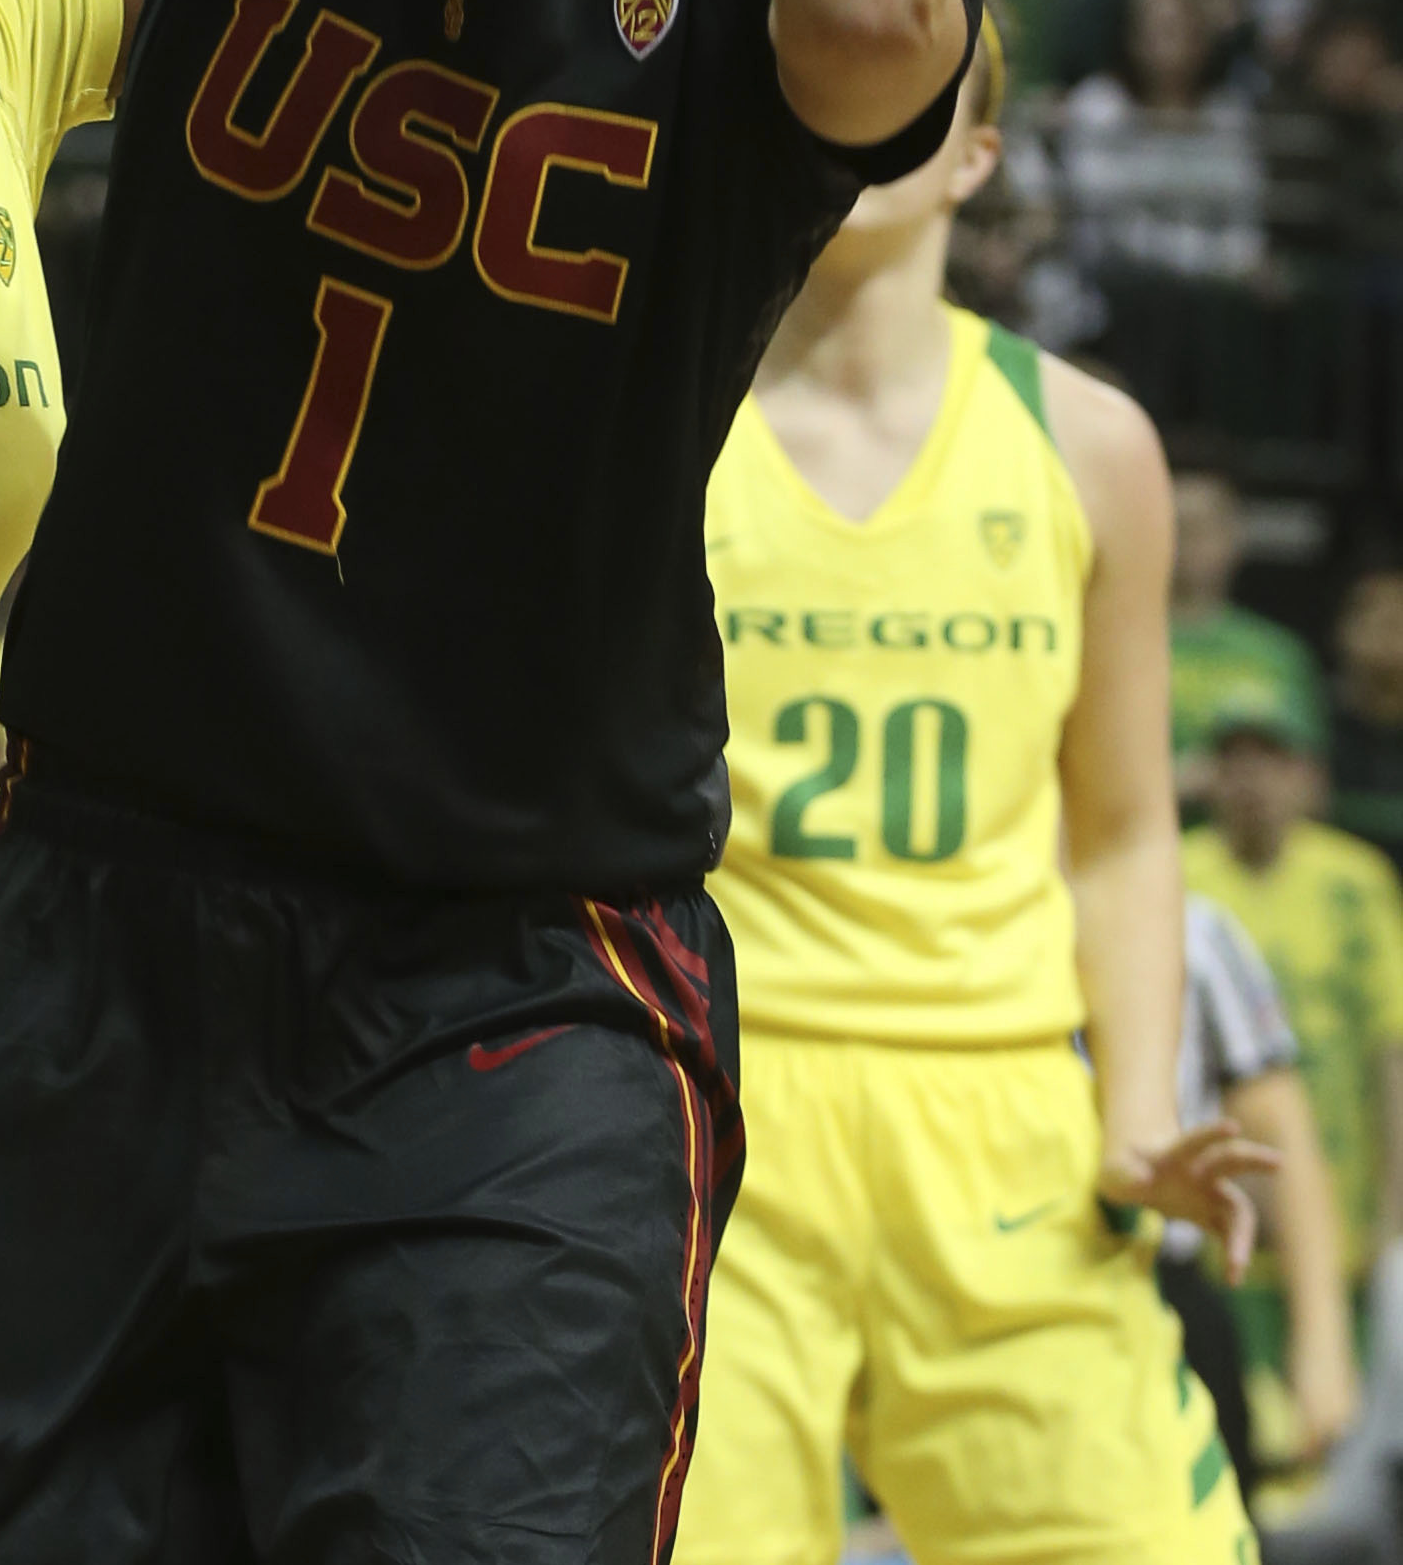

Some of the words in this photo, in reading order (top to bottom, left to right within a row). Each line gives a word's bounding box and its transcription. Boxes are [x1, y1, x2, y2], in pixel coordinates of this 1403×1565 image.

[247, 275, 394, 557] 1
[725, 608, 1059, 653] REGON
[770, 693, 969, 864] 20
